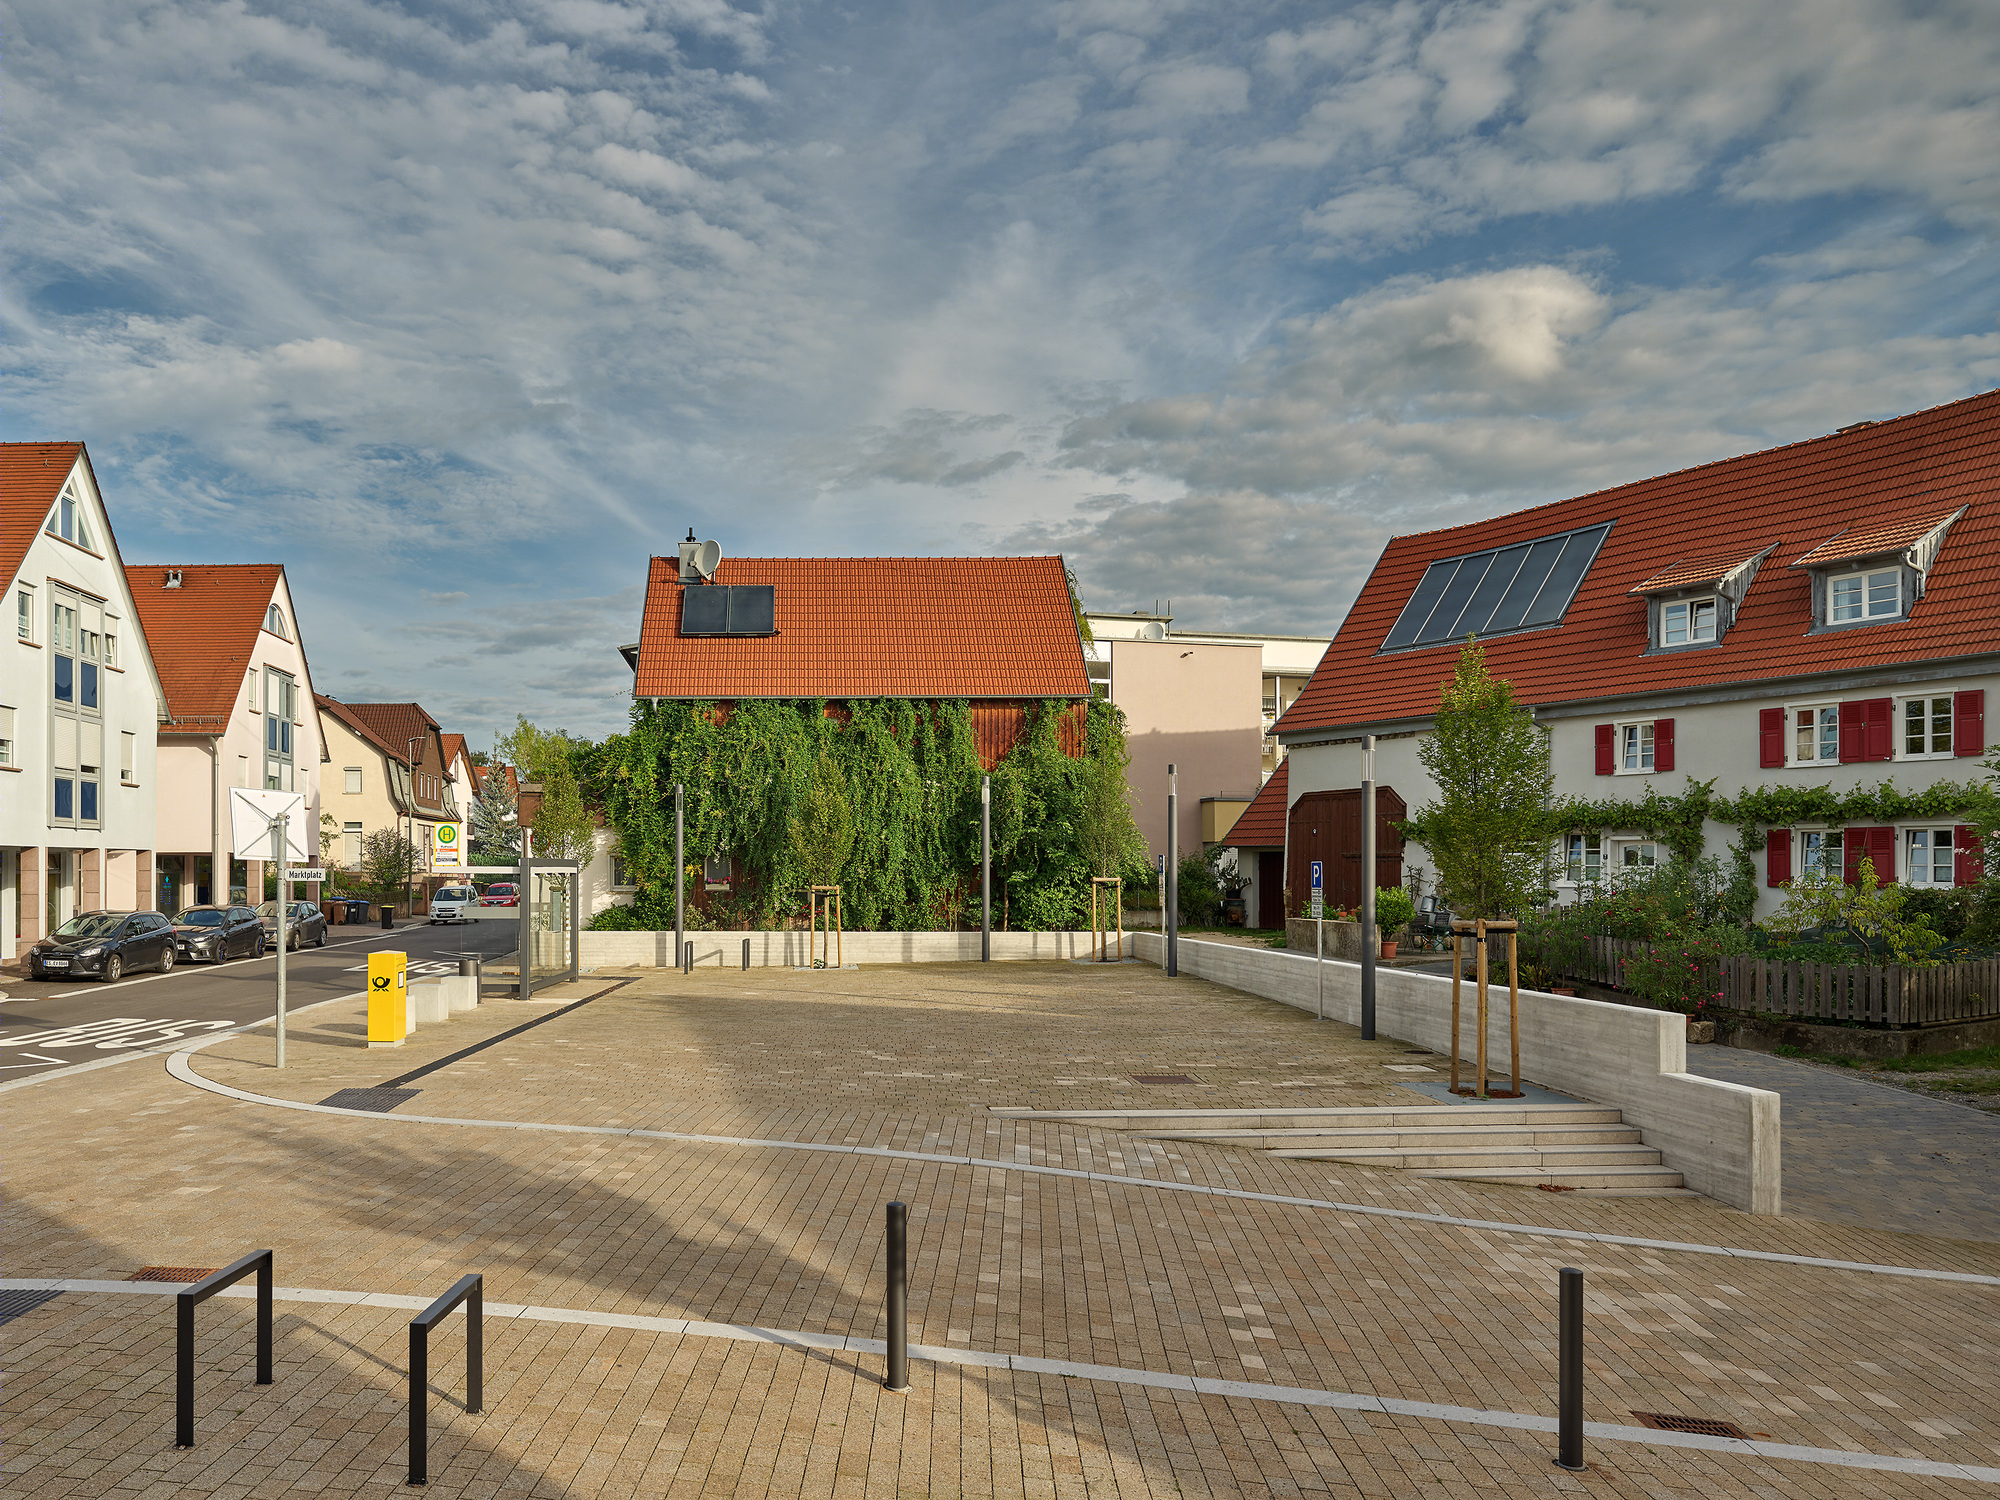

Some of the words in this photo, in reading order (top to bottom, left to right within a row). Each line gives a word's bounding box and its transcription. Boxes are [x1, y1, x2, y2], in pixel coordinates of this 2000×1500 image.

[443, 829, 451, 840] H
[289, 871, 322, 880] Marktplatz
[1313, 865, 1320, 885] P
[0, 1018, 236, 1049] BUS
